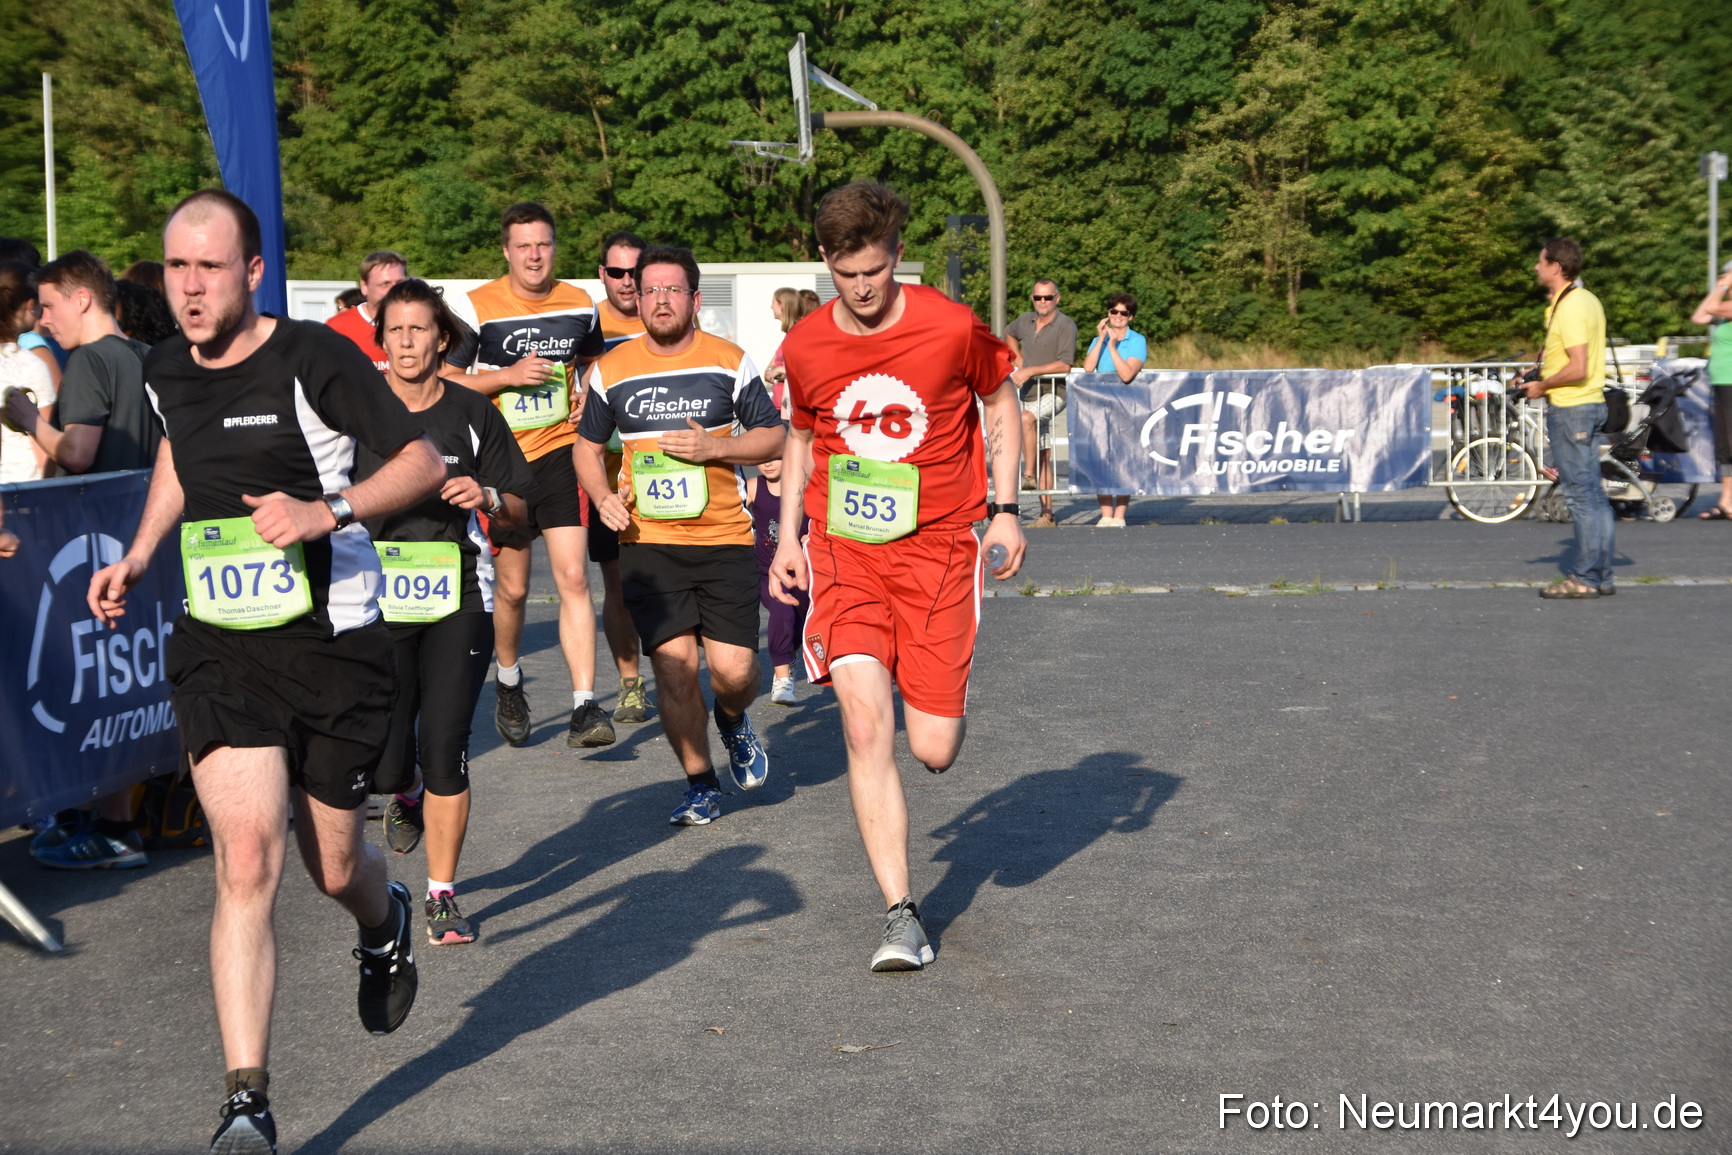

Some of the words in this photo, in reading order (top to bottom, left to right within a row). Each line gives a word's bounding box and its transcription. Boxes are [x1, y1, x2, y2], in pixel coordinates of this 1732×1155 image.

[516, 336, 575, 352] Fischer
[522, 349, 571, 358] AOMOBILE
[514, 390, 553, 413] 411
[638, 396, 712, 414] Fischer
[231, 414, 279, 428] PFLEIDERER
[645, 410, 707, 420] AUTOMOBILE
[848, 399, 913, 440] 48
[1179, 421, 1356, 456] Fischer
[1195, 458, 1342, 475] AUTOMOBILE
[646, 477, 689, 500] 431
[843, 489, 897, 522] 553
[848, 520, 866, 529] Marcel
[865, 524, 890, 533] Brunsch
[198, 558, 296, 601] 1073
[380, 574, 451, 600] 1094
[217, 606, 246, 615] Thomas
[245, 603, 282, 613] Daschner
